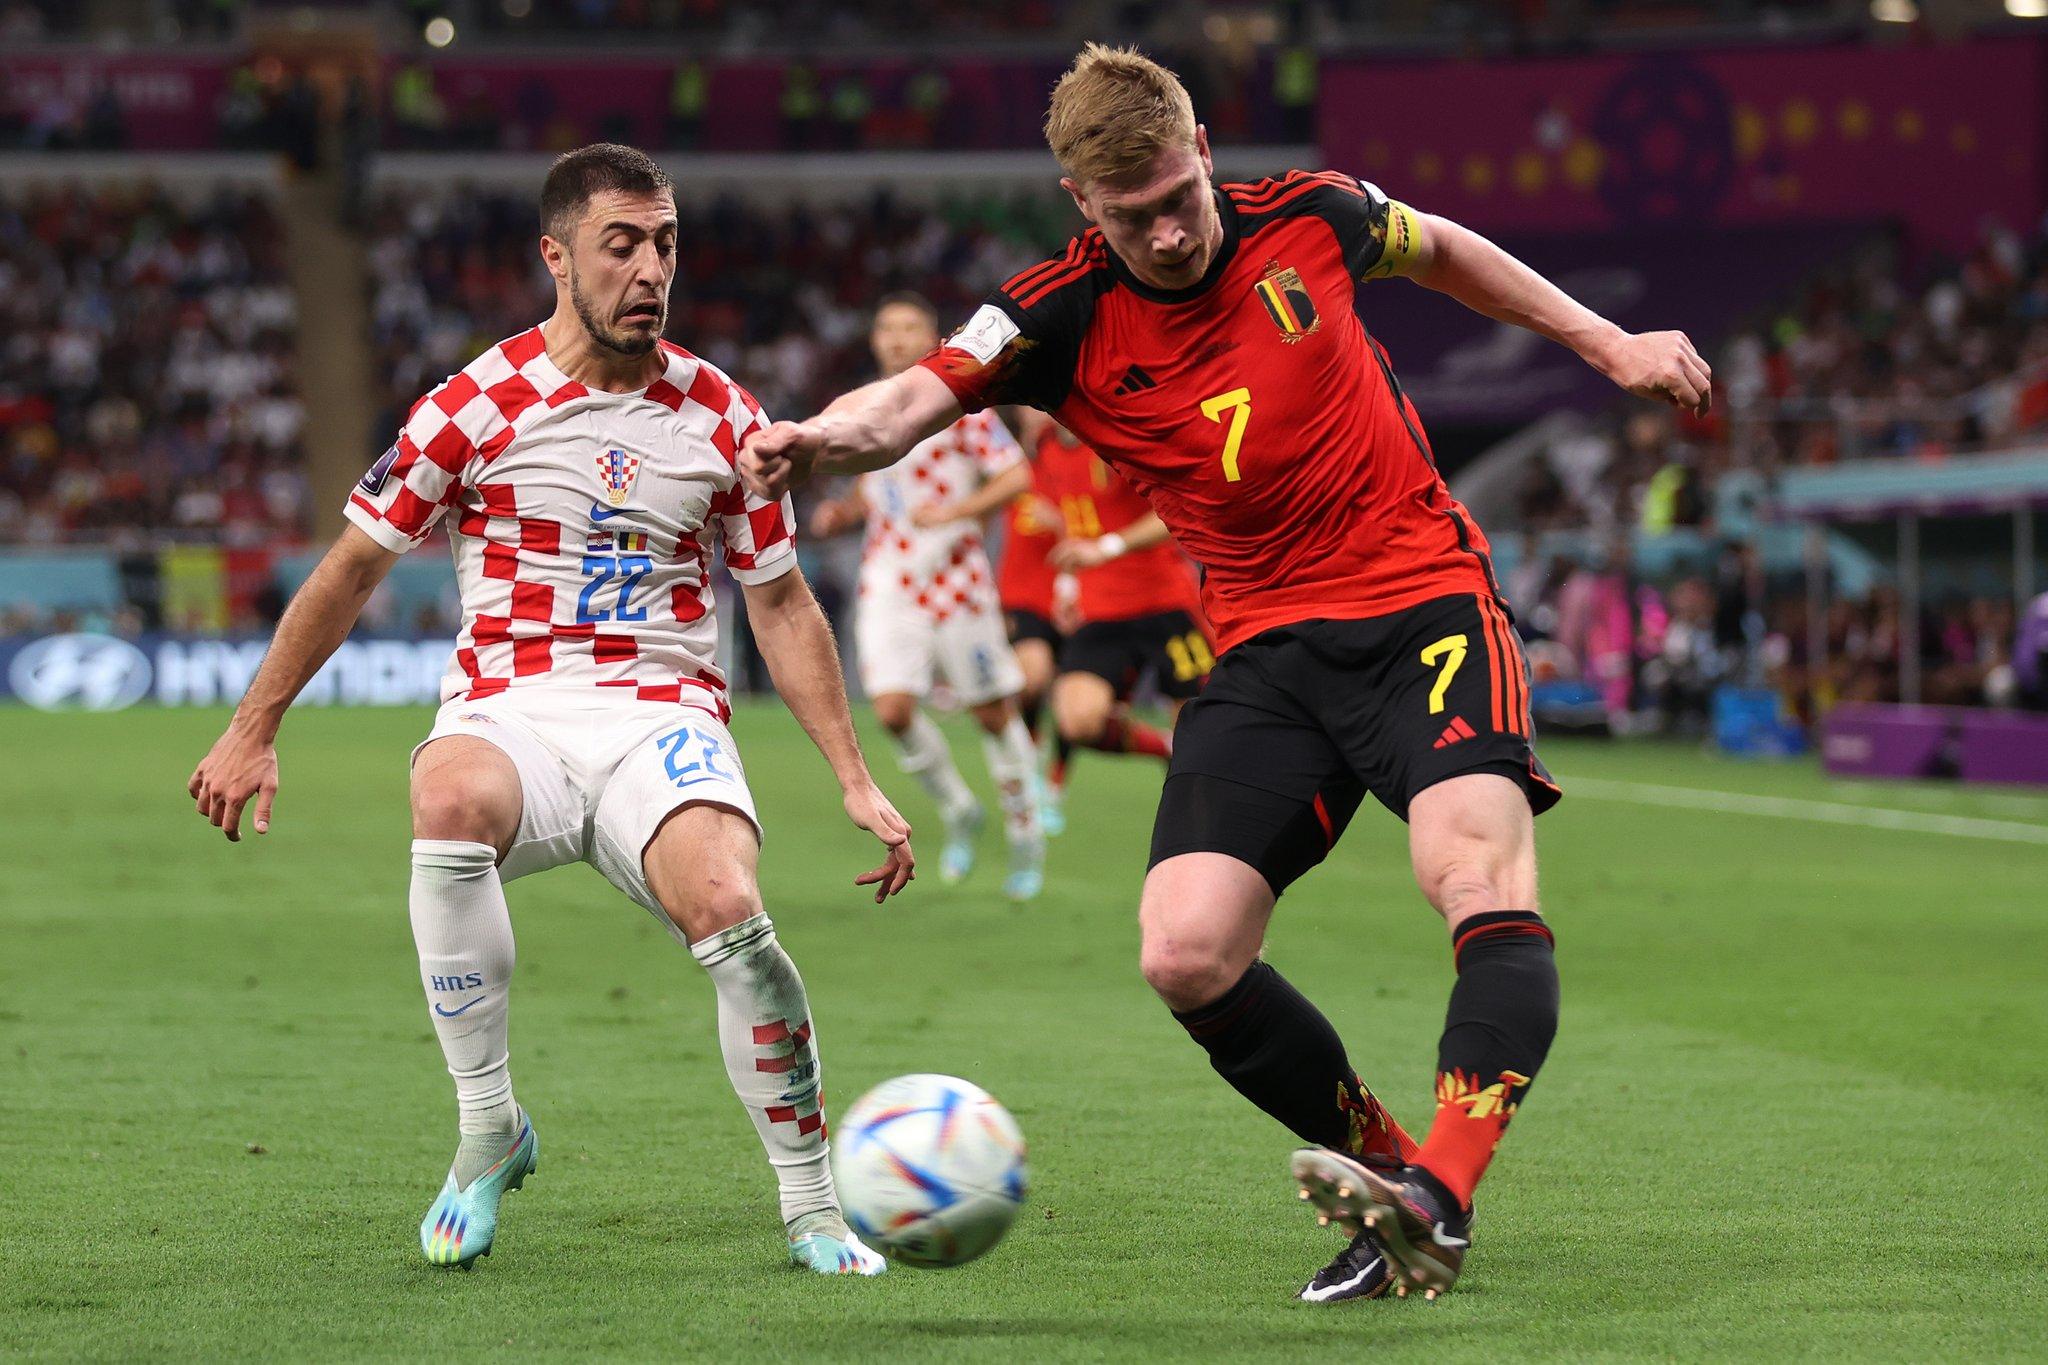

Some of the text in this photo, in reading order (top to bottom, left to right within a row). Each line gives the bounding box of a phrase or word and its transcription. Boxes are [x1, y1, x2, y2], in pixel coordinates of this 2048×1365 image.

[1200, 387, 1251, 482] 7
[576, 555, 653, 624] 22
[1165, 630, 1217, 682] 11
[1420, 633, 1468, 715] 7
[656, 727, 736, 783] 22
